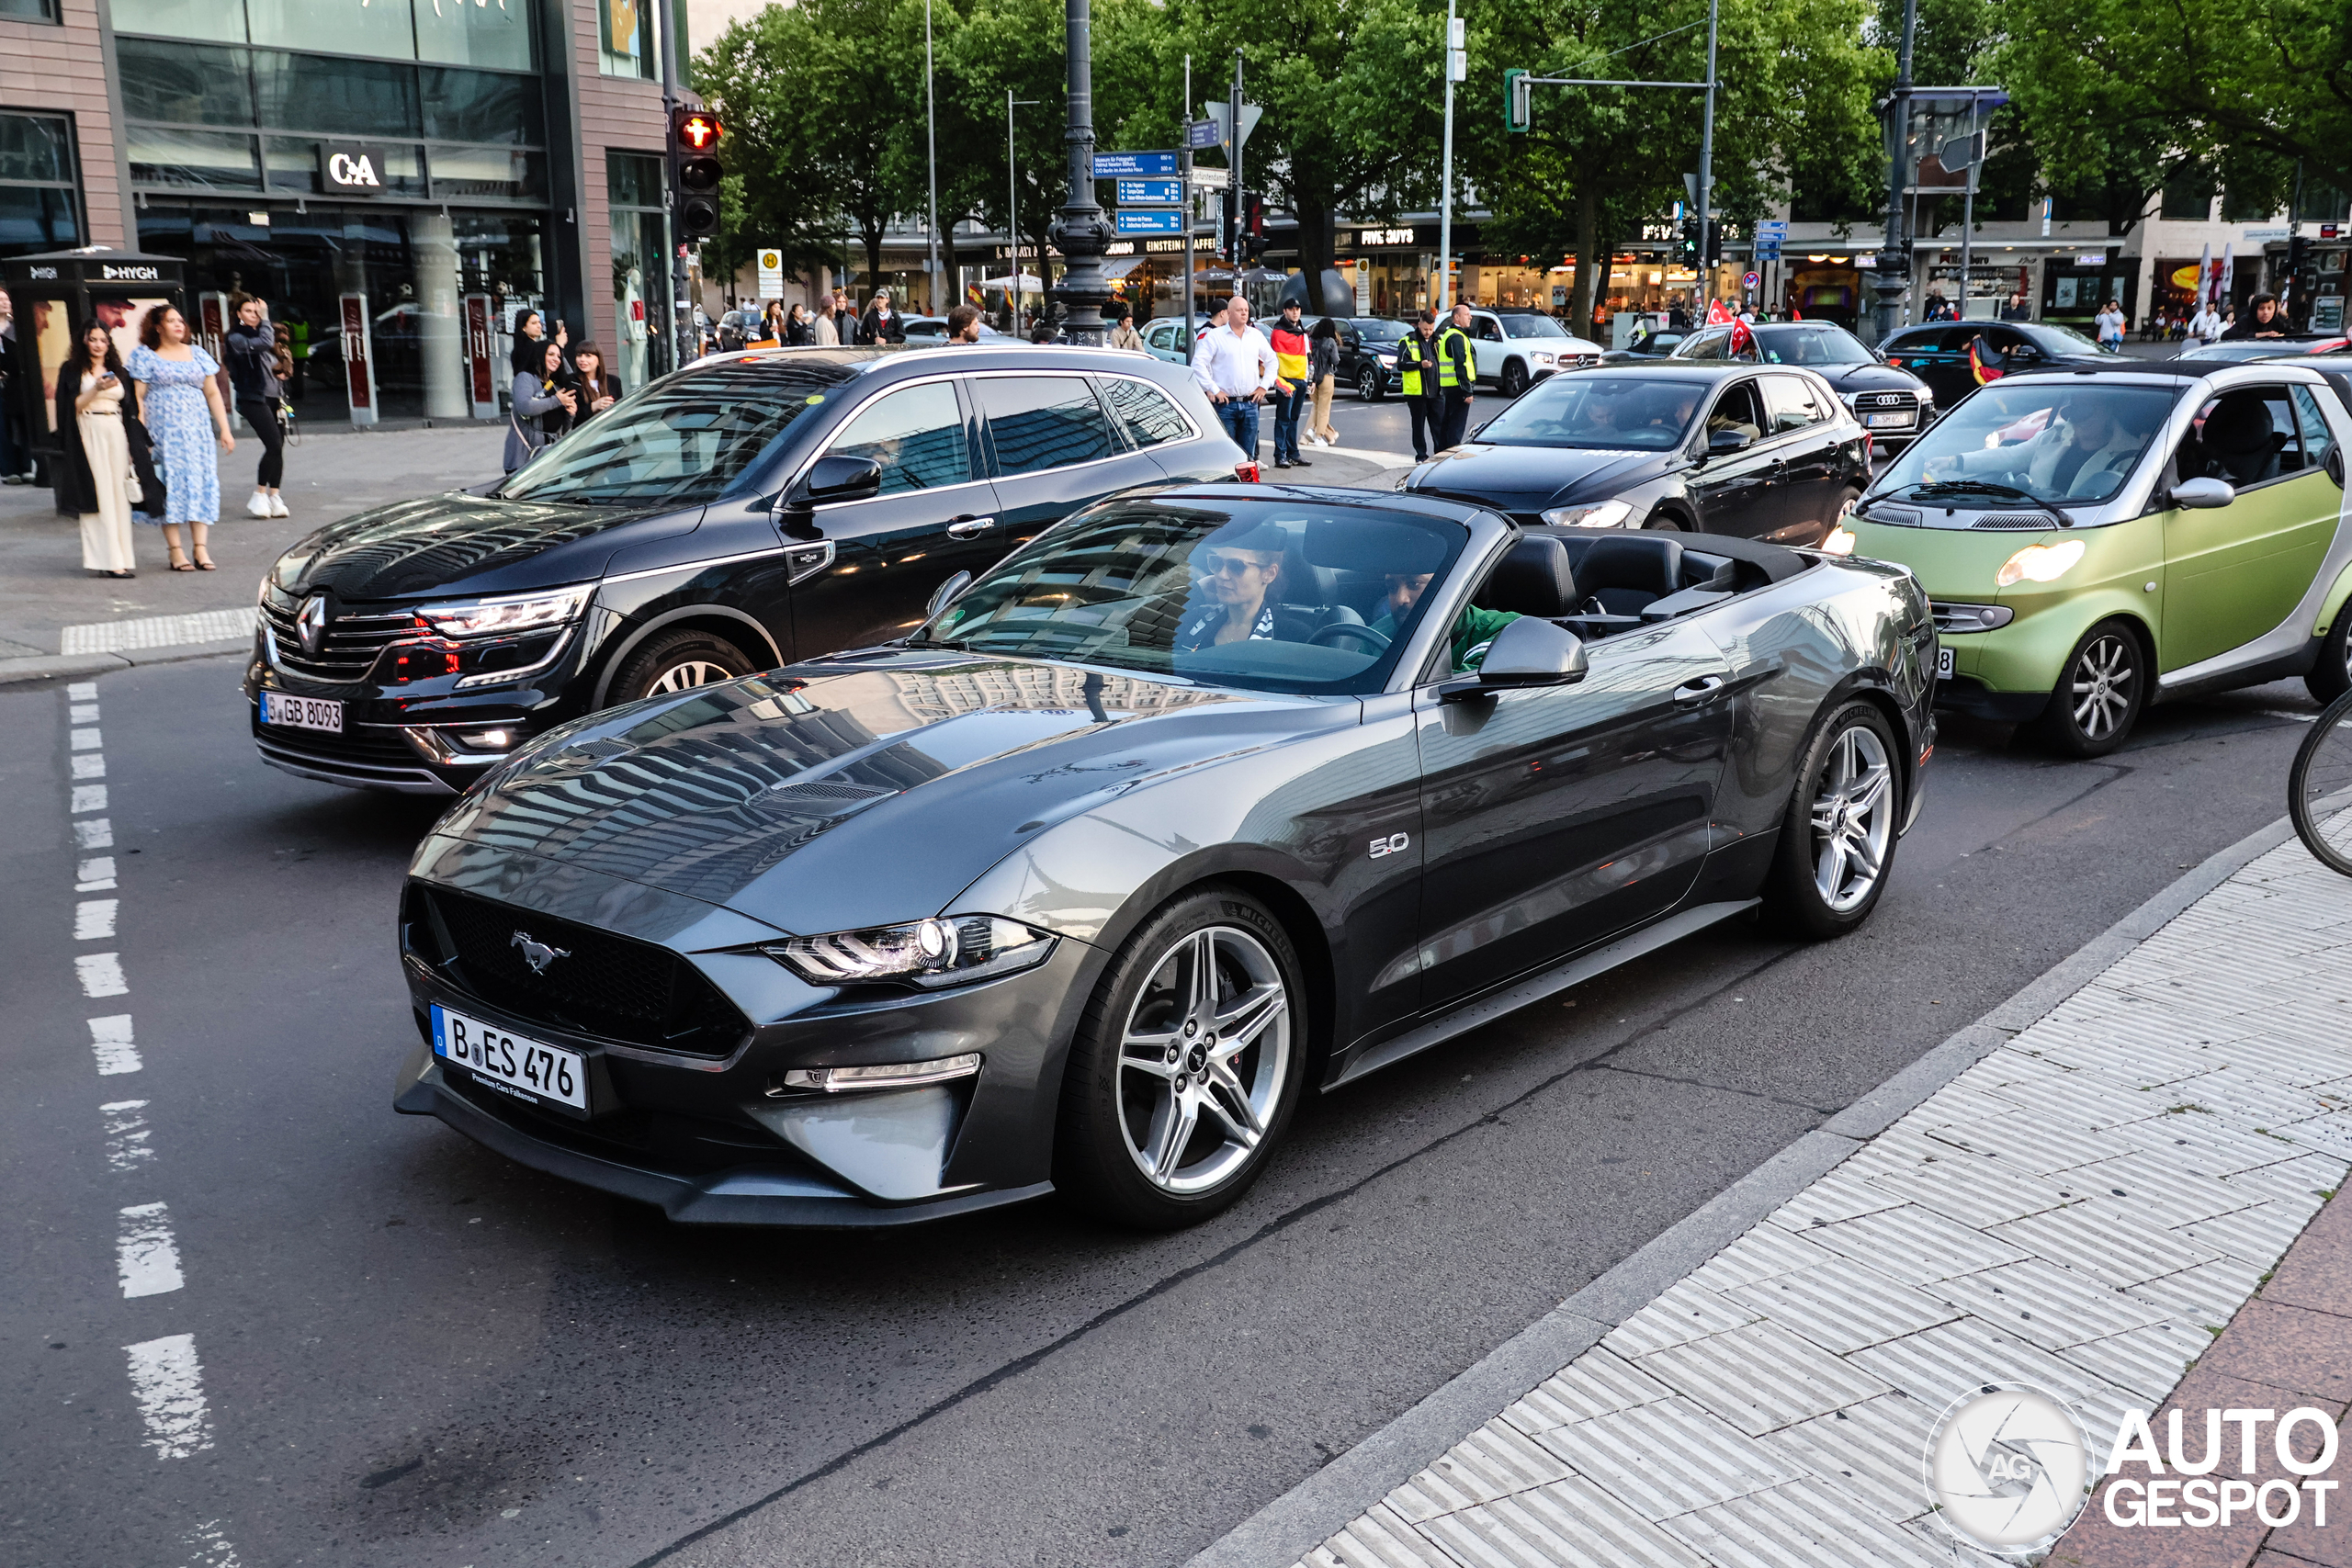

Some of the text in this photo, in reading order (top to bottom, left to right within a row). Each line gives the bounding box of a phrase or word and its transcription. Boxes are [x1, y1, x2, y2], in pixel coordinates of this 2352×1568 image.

[329, 153, 380, 186] C&A
[1146, 239, 1182, 253] EINSTEIN
[1361, 231, 1384, 245] FIVE
[1385, 228, 1414, 244] GUYS
[118, 265, 159, 280] HYGH
[1581, 449, 1652, 458] MILES
[1939, 651, 1951, 671] 8
[268, 696, 341, 728] B GB 8093
[1368, 831, 1410, 860] 5.0
[1239, 906, 1295, 964] MICHELIN
[436, 1034, 444, 1047] D
[452, 1018, 574, 1098] B ES 476
[471, 1072, 538, 1105] Premium Cars Falkensee
